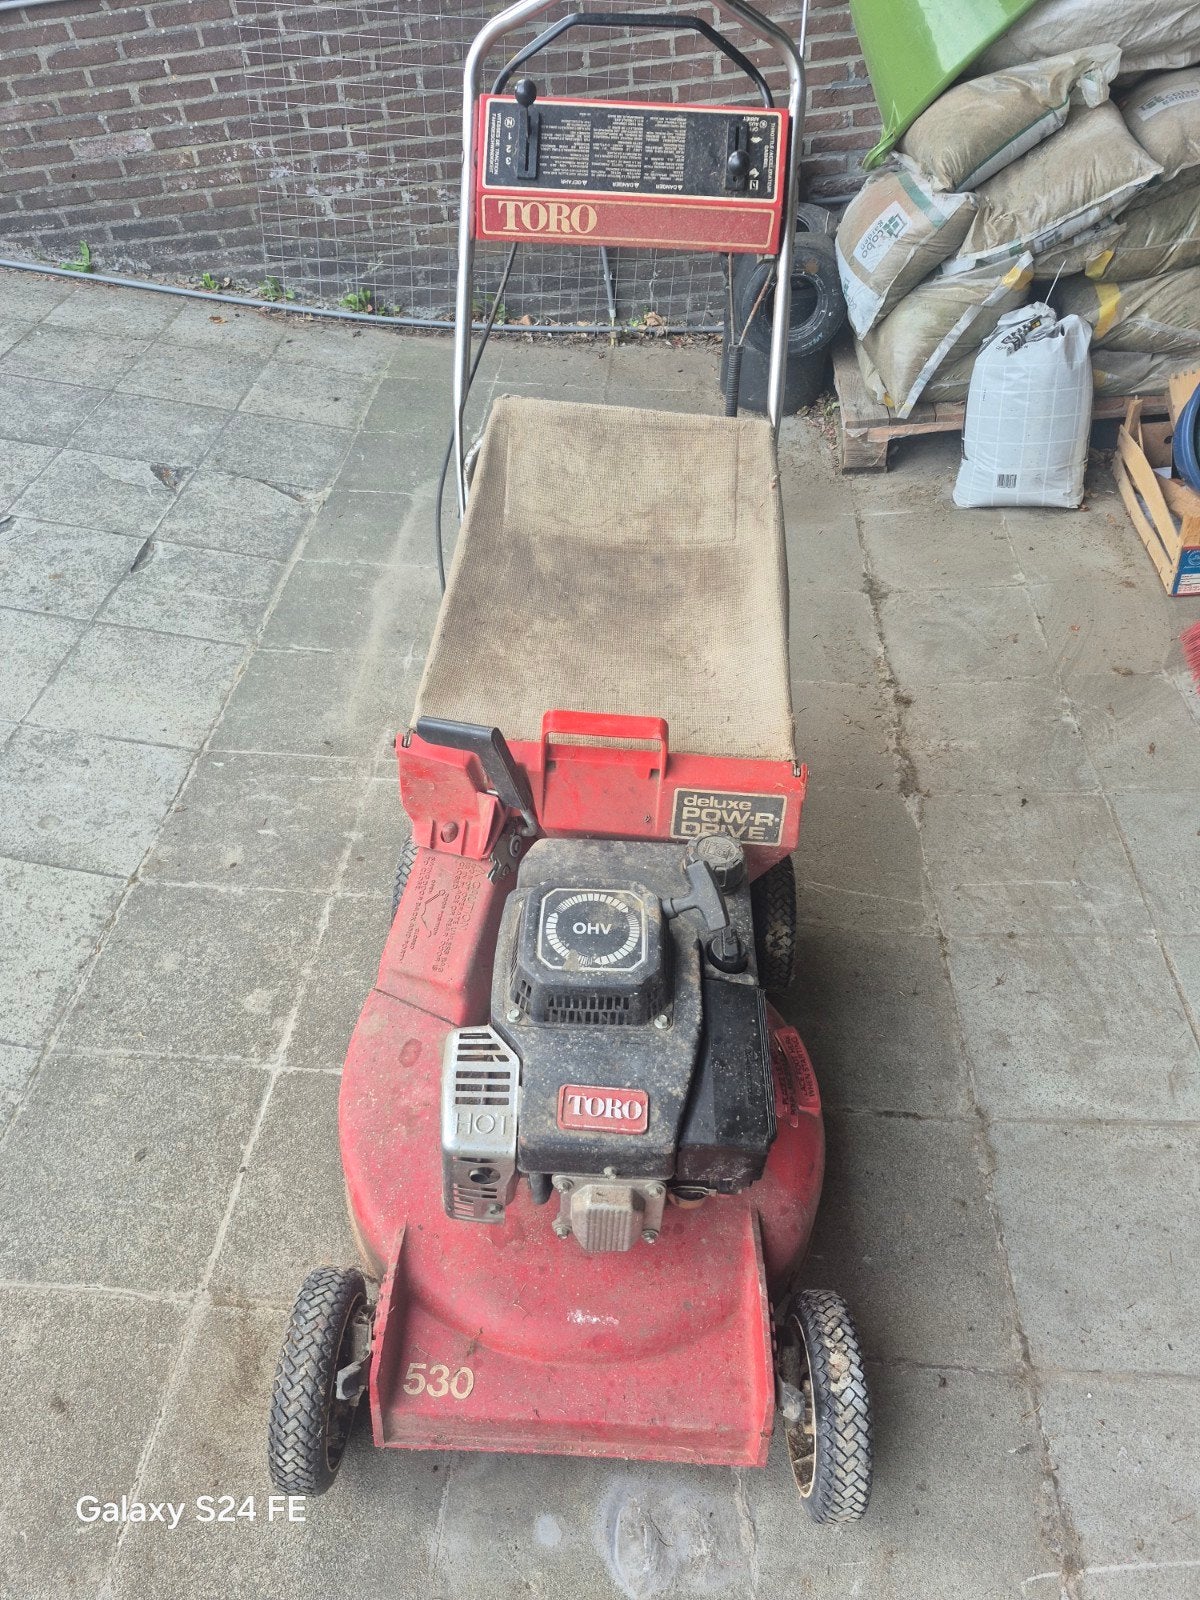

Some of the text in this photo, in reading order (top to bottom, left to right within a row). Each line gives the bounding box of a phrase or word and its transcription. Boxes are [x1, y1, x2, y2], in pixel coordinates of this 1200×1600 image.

[498, 200, 598, 234] TORO
[684, 795, 752, 810] deluxe
[572, 922, 612, 934] OHV
[794, 1036, 810, 1072] STARTING
[568, 1095, 642, 1120] TORO
[457, 1112, 512, 1134] HOT
[403, 1362, 474, 1399] 530
